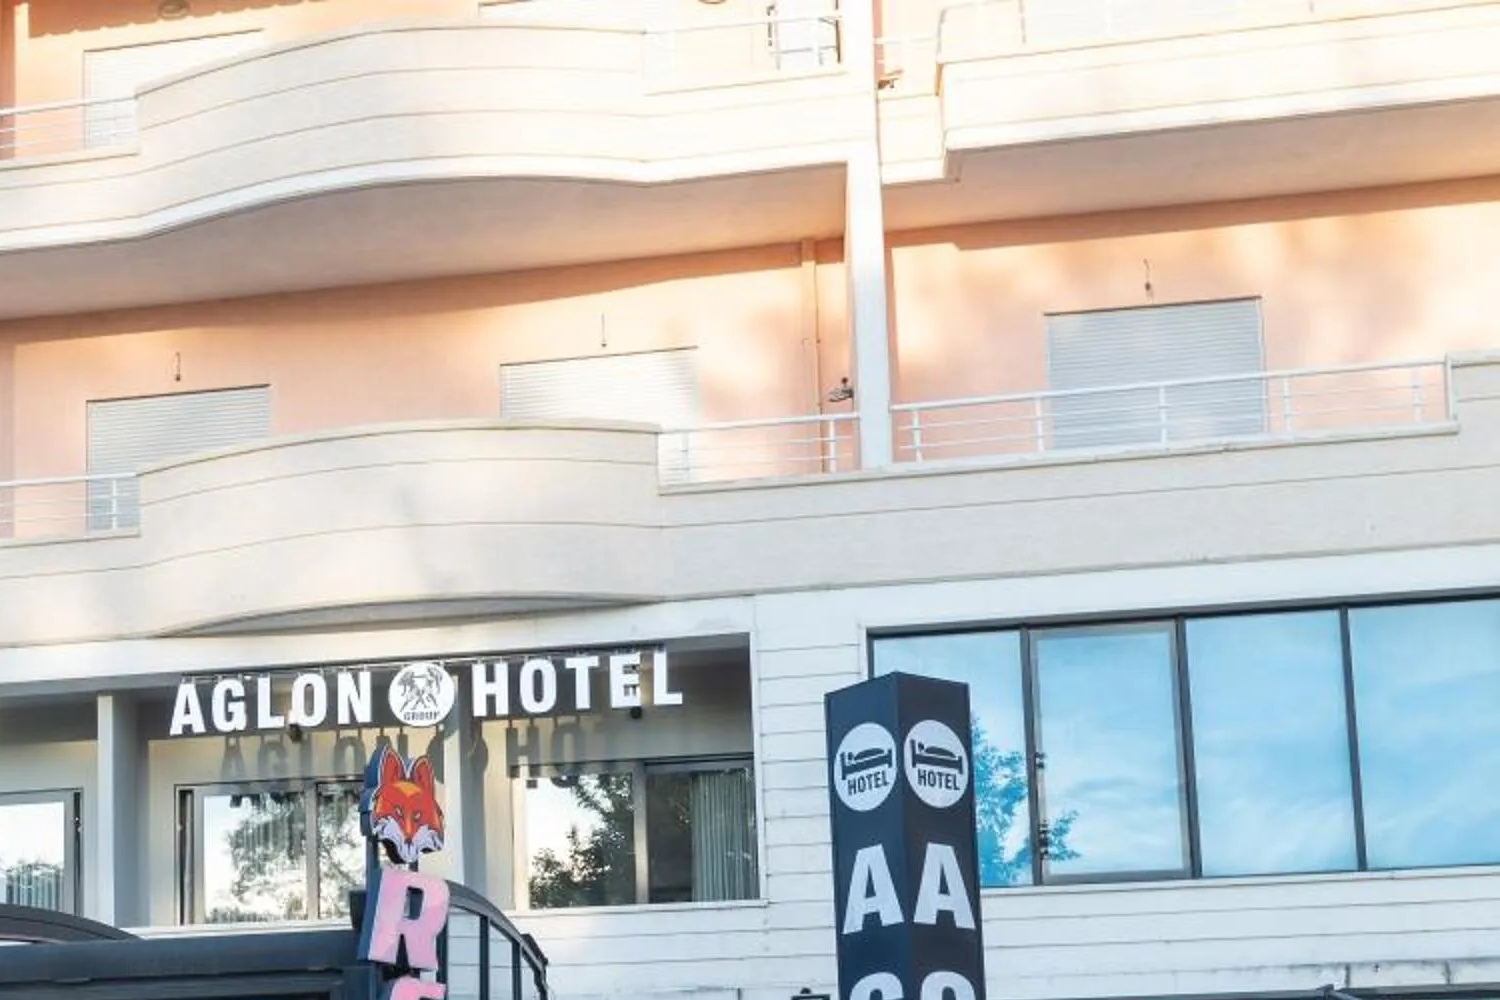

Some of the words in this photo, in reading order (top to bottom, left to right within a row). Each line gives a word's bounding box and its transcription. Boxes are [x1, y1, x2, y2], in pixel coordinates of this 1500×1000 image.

[169, 671, 372, 735] AGLON
[472, 648, 683, 717] HOTEL
[847, 770, 890, 795] HOTEL
[916, 768, 961, 791] HOTEL
